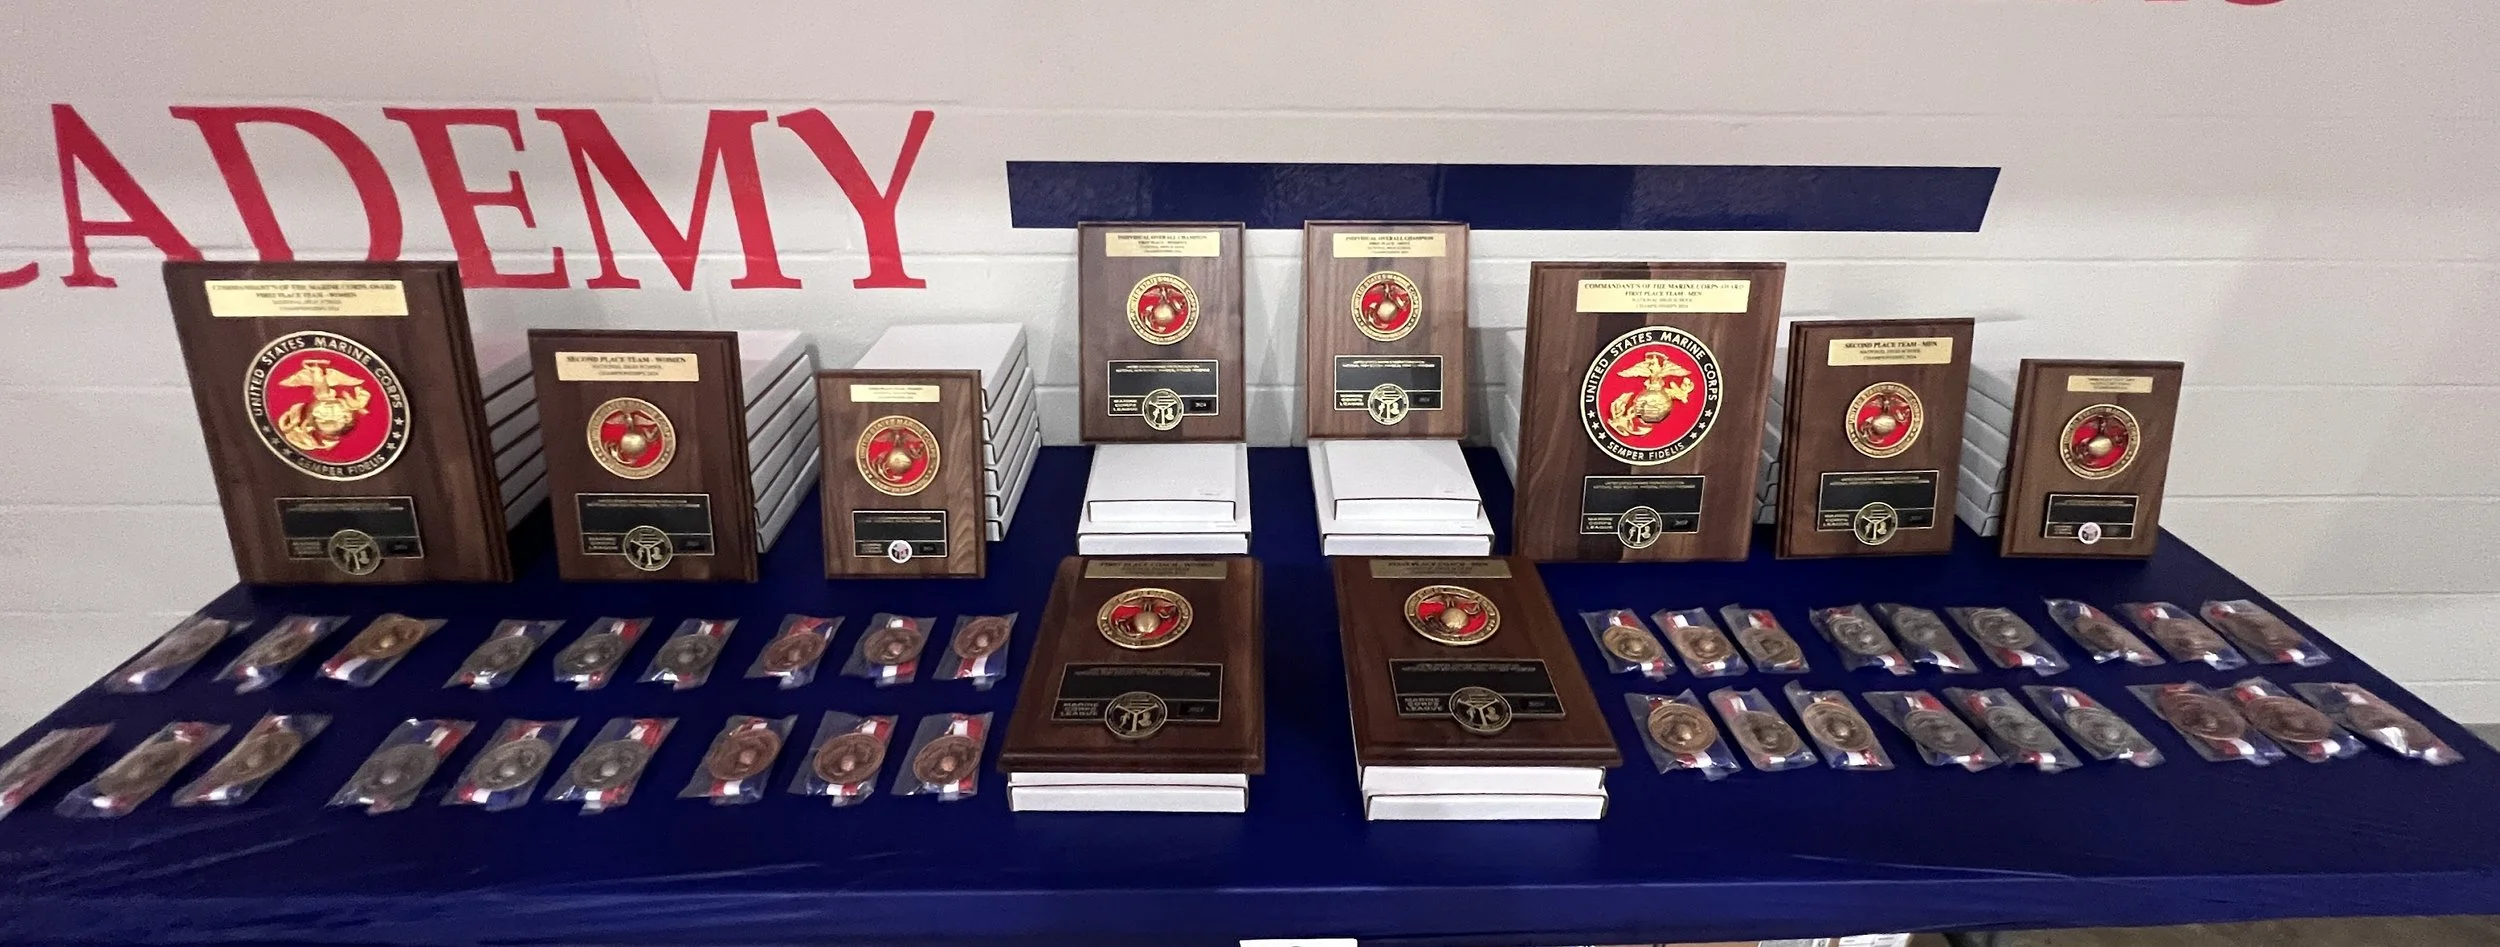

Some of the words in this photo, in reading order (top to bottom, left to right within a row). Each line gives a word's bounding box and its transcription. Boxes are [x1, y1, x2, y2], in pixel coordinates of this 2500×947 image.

[0, 103, 935, 290] ADEMY
[250, 368, 265, 416] UNITED
[261, 337, 305, 366] STATES
[314, 336, 372, 366] MARINE
[374, 367, 403, 409] CORPS
[1586, 358, 1609, 403] UNITED
[1611, 332, 1653, 357] STATES
[1660, 331, 1706, 360] MARINE
[1703, 362, 1718, 401] CORPS
[298, 457, 343, 476] SEMPER
[348, 454, 386, 475] FIDELIS
[1607, 441, 1645, 460] SEMPER
[1648, 441, 1685, 461] FIDELIS
